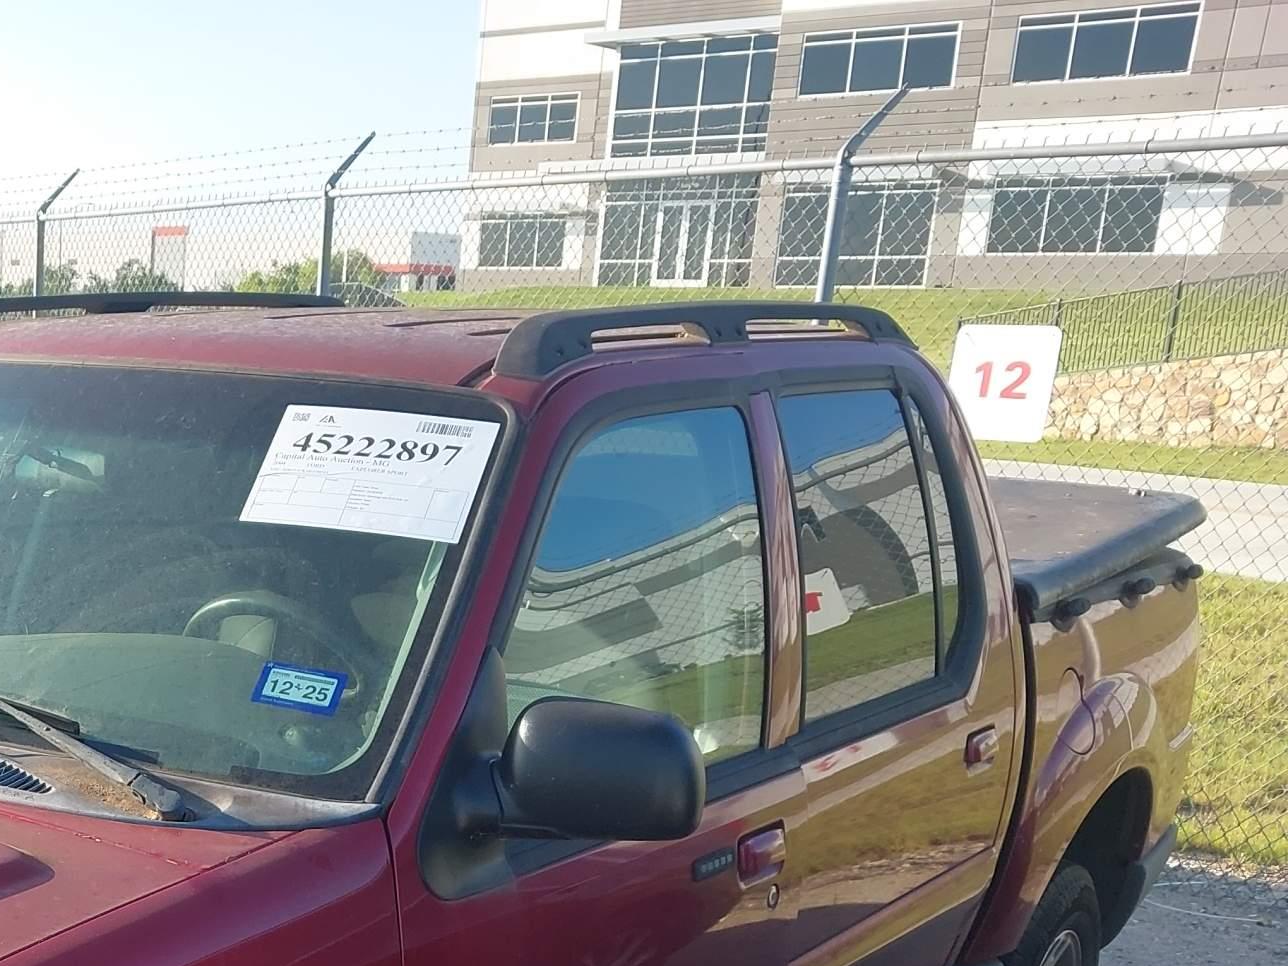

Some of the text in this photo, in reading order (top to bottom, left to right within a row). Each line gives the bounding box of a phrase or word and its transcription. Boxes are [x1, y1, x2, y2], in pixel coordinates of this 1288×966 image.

[975, 361, 1032, 399] 12
[275, 452, 305, 460] Capital
[307, 454, 328, 462] Auto
[330, 456, 364, 465] Auction
[292, 432, 463, 466] 45222897
[270, 679, 330, 702] 12 25
